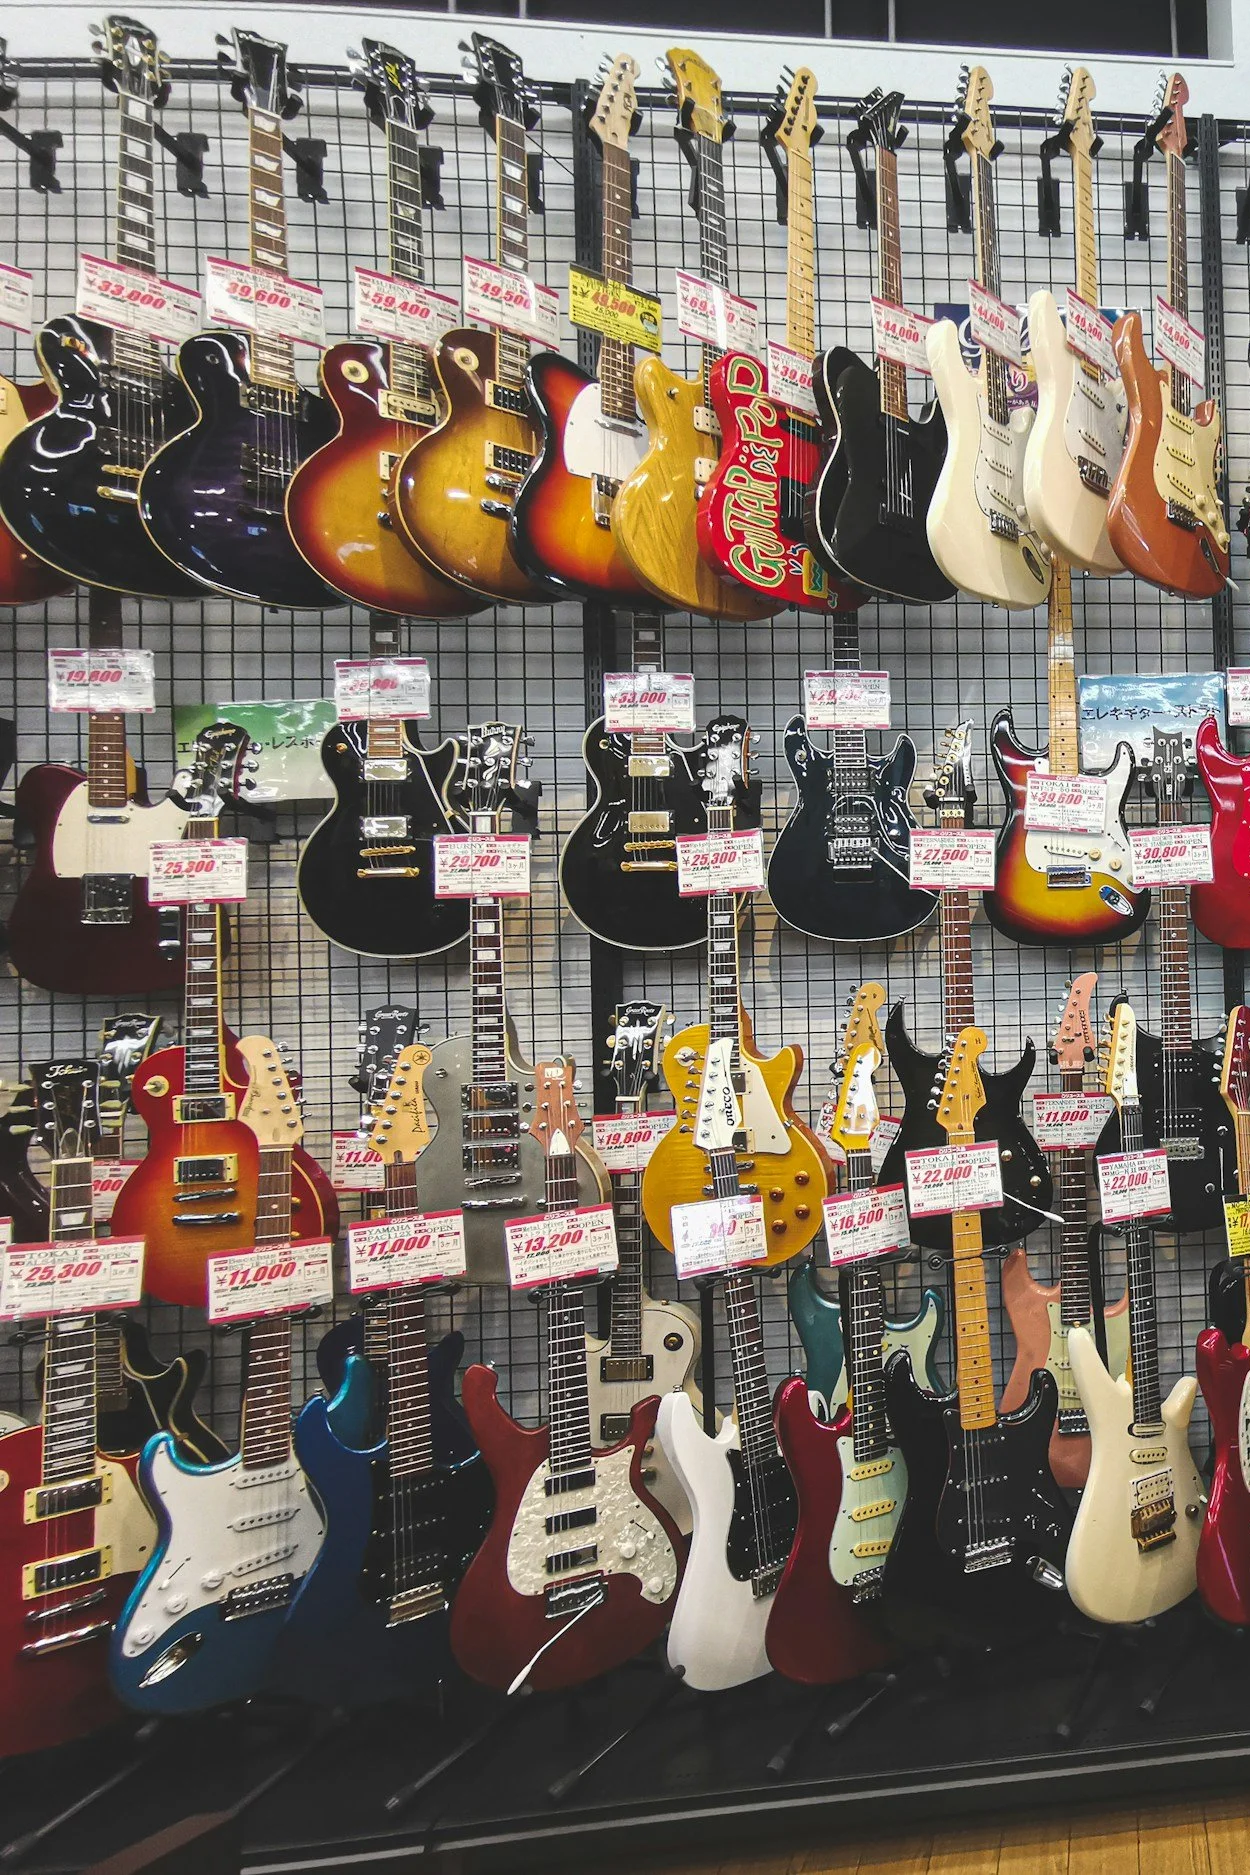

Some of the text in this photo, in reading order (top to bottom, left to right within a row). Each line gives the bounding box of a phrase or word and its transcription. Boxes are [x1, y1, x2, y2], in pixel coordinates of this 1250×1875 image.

[481, 725, 506, 739] Burny
[1030, 791, 1083, 805] ¥39,600
[682, 850, 737, 867] ¥25,300
[914, 848, 968, 861] ¥27,500
[1134, 845, 1188, 860] ¥30,800
[440, 855, 501, 868] ¥29,700
[1037, 1109, 1090, 1122] ¥11,000
[648, 1122, 670, 1130] OPEN
[597, 1130, 652, 1145] ¥19,800
[921, 1153, 955, 1164] TOKAI
[966, 1156, 991, 1164] OPEN
[912, 1164, 974, 1185] ¥22,000
[1103, 1172, 1148, 1190] ¥22,000
[735, 1211, 755, 1220] OPEN
[829, 1207, 885, 1233] ¥16,500
[367, 1224, 411, 1235] YAMAHA
[427, 1223, 454, 1234] OPEN
[577, 1218, 604, 1230] OPEN
[356, 1234, 431, 1258] ¥11,000
[512, 1229, 584, 1254] ¥13,200
[26, 1249, 79, 1260] TOKAI
[99, 1251, 131, 1261] OPEN
[10, 1261, 102, 1283] ¥25,300
[215, 1261, 297, 1288] ¥11,000
